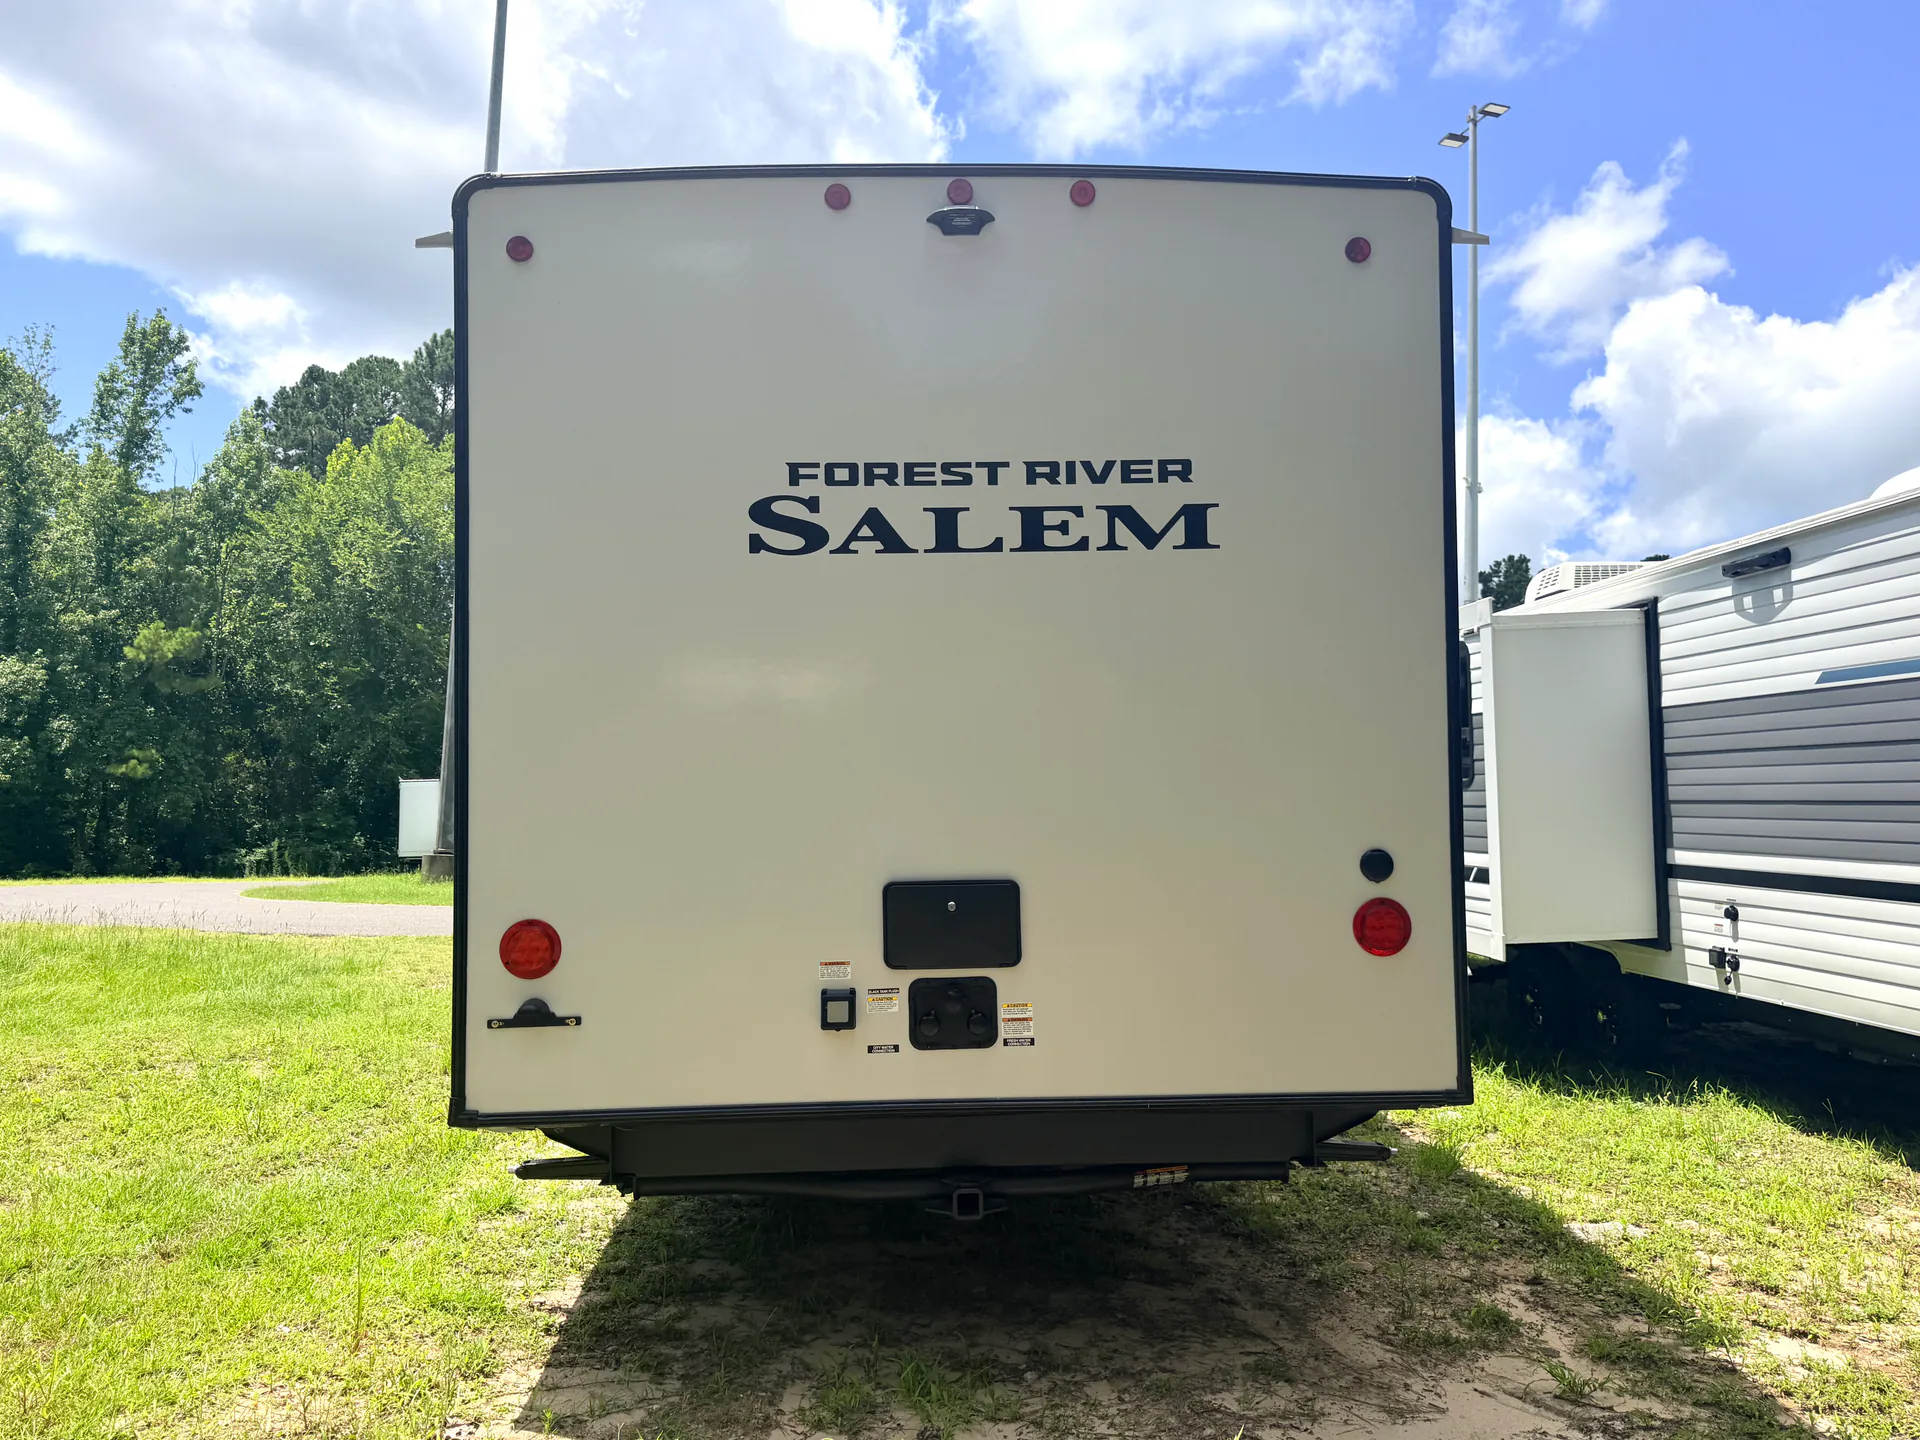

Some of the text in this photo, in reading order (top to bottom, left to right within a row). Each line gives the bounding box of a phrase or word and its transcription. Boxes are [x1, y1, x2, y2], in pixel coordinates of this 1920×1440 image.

[786, 459, 1193, 486] FOREST RIVER
[749, 495, 1220, 555] SALEM
